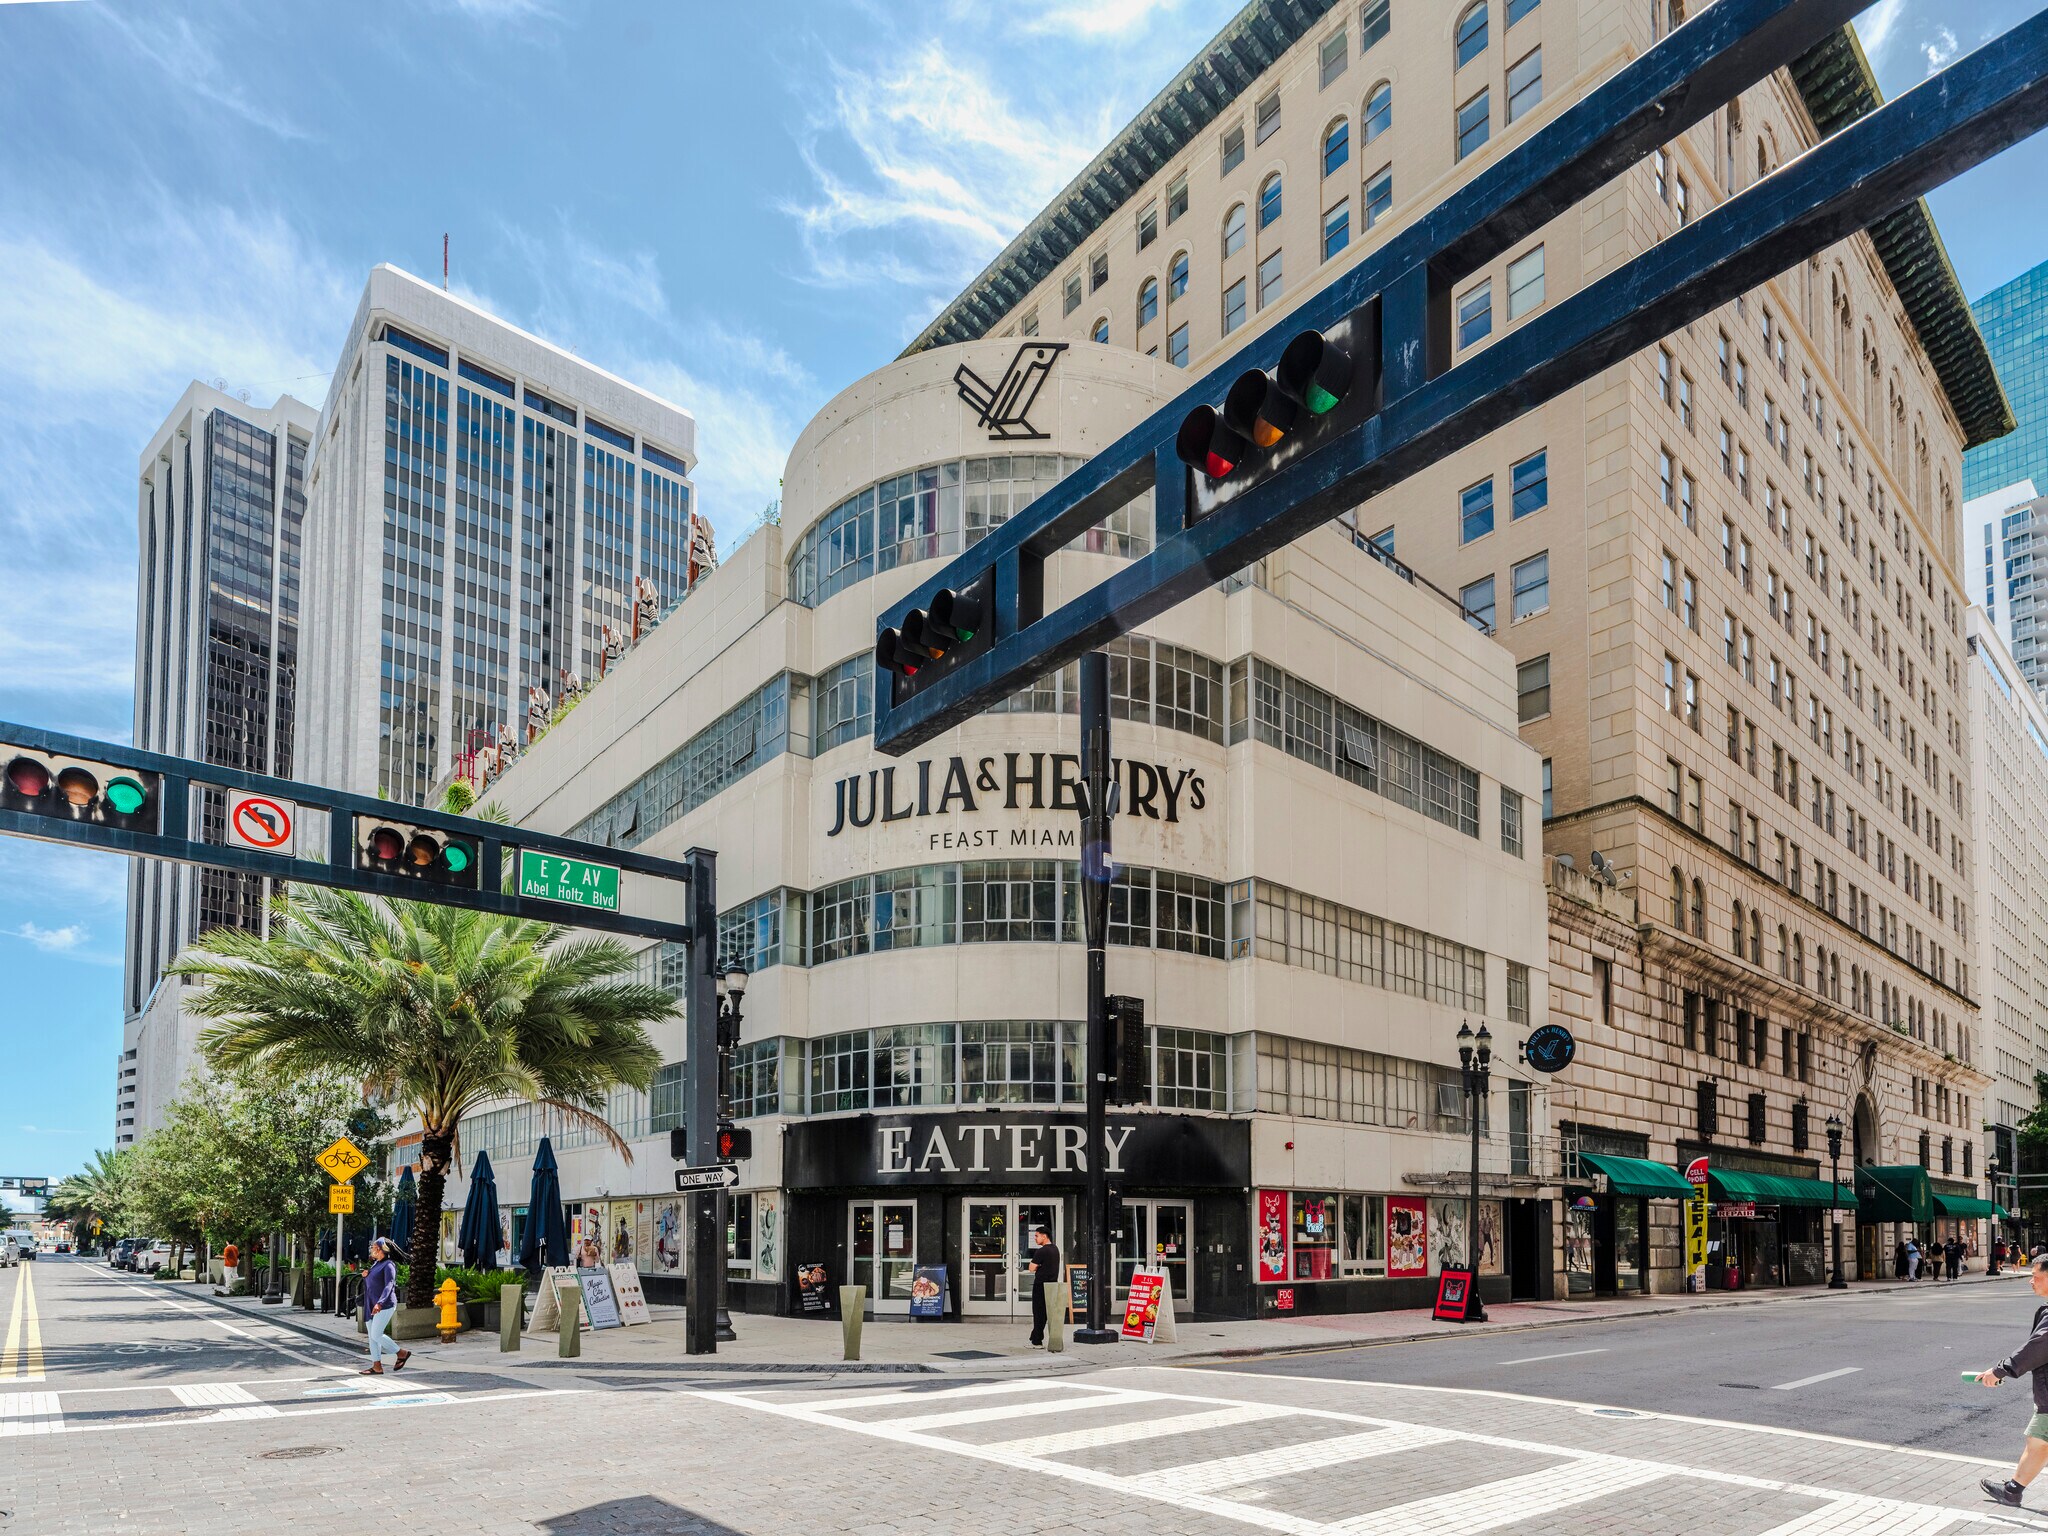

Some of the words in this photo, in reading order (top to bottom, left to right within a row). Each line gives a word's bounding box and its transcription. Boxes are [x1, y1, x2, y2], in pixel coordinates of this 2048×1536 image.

[930, 829, 999, 851] FEAST
[1010, 829, 1075, 847] MIAM
[540, 859, 549, 878] E
[560, 861, 571, 884] 2
[582, 867, 601, 887] AV
[525, 879, 549, 896] Abel
[558, 884, 584, 902] Holtz
[592, 890, 614, 907] Blvd
[877, 1124, 1136, 1173] EATERY
[1690, 1168, 1704, 1176] CELL
[682, 1175, 701, 1185] ONE
[705, 1172, 724, 1182] WAY
[587, 1279, 603, 1291] Magic
[593, 1287, 603, 1297] City
[1280, 1290, 1292, 1299] FDC
[589, 1294, 610, 1306] Collective
